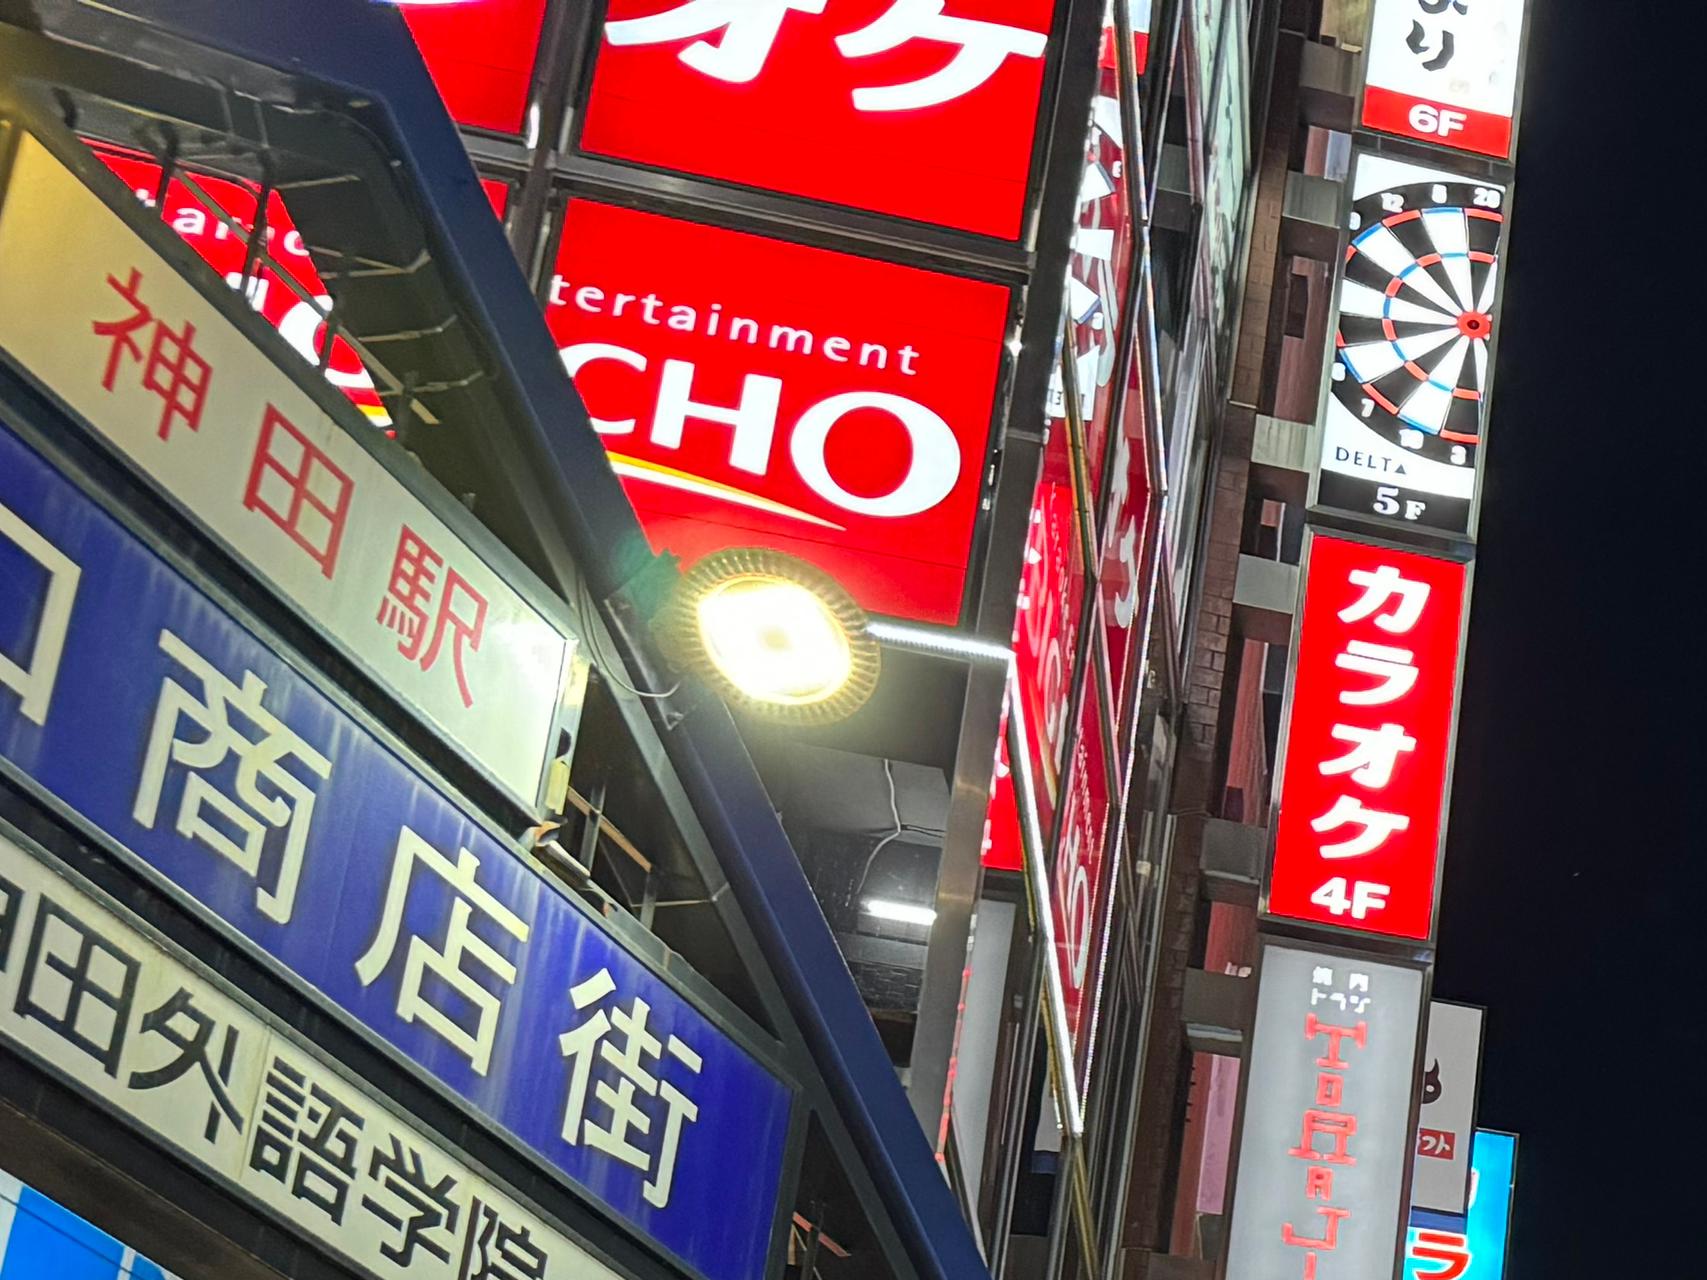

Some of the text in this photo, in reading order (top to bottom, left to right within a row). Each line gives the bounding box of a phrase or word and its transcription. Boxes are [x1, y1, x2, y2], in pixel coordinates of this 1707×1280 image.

[1408, 104, 1465, 137] 6F
[1336, 446, 1407, 475] DELTA
[91, 266, 488, 708] 神田駅
[1310, 565, 1432, 860] カラオケ
[1311, 878, 1390, 920] 4F
